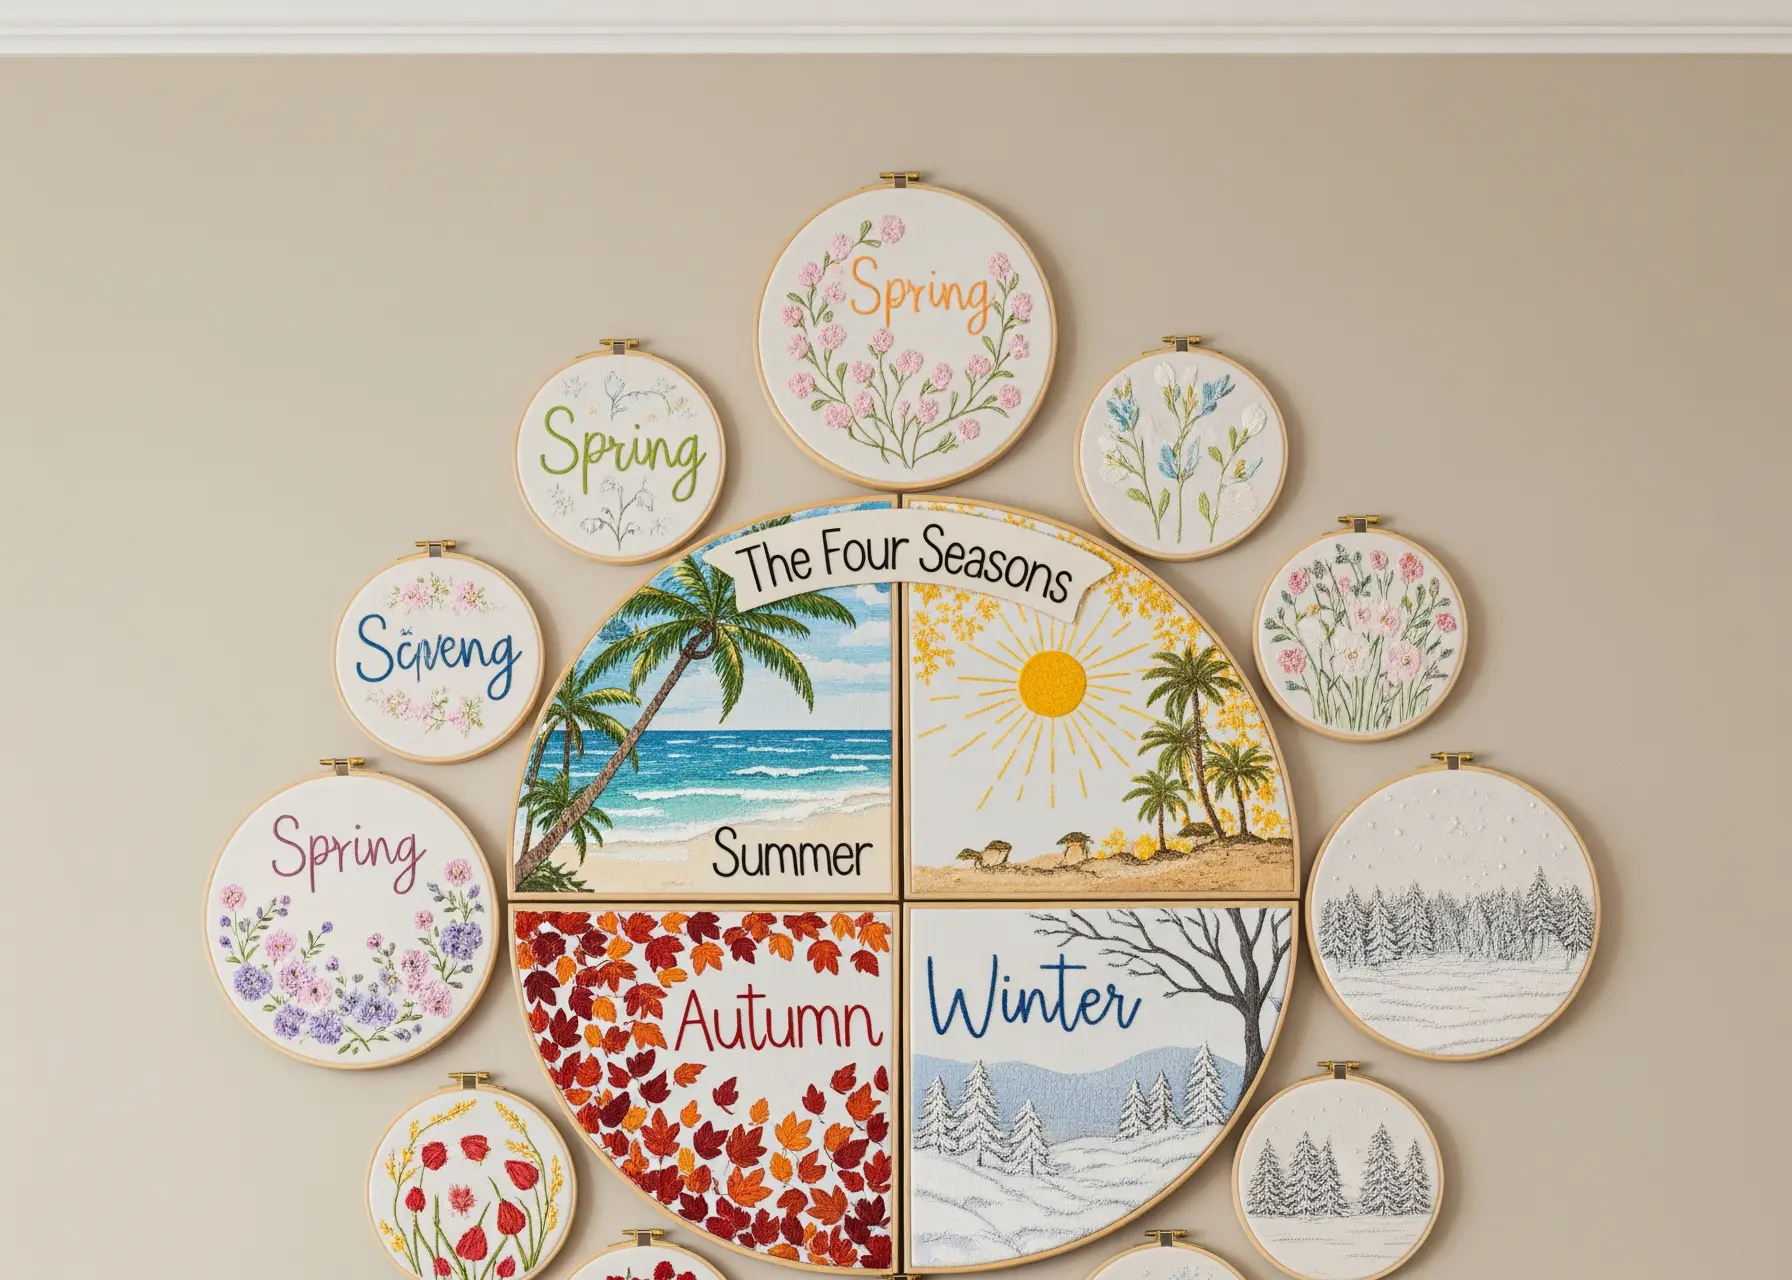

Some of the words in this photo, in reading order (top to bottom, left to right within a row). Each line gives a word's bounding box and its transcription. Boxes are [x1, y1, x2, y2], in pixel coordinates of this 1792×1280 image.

[848, 255, 997, 335] Spring
[539, 405, 707, 502] Spring
[734, 541, 812, 593] The
[821, 527, 910, 575] Four
[918, 523, 1073, 604] Seasons
[271, 814, 427, 895] Spring
[712, 825, 876, 878] Summer
[674, 983, 884, 1051] Autumn
[927, 953, 1142, 1039] Winter
